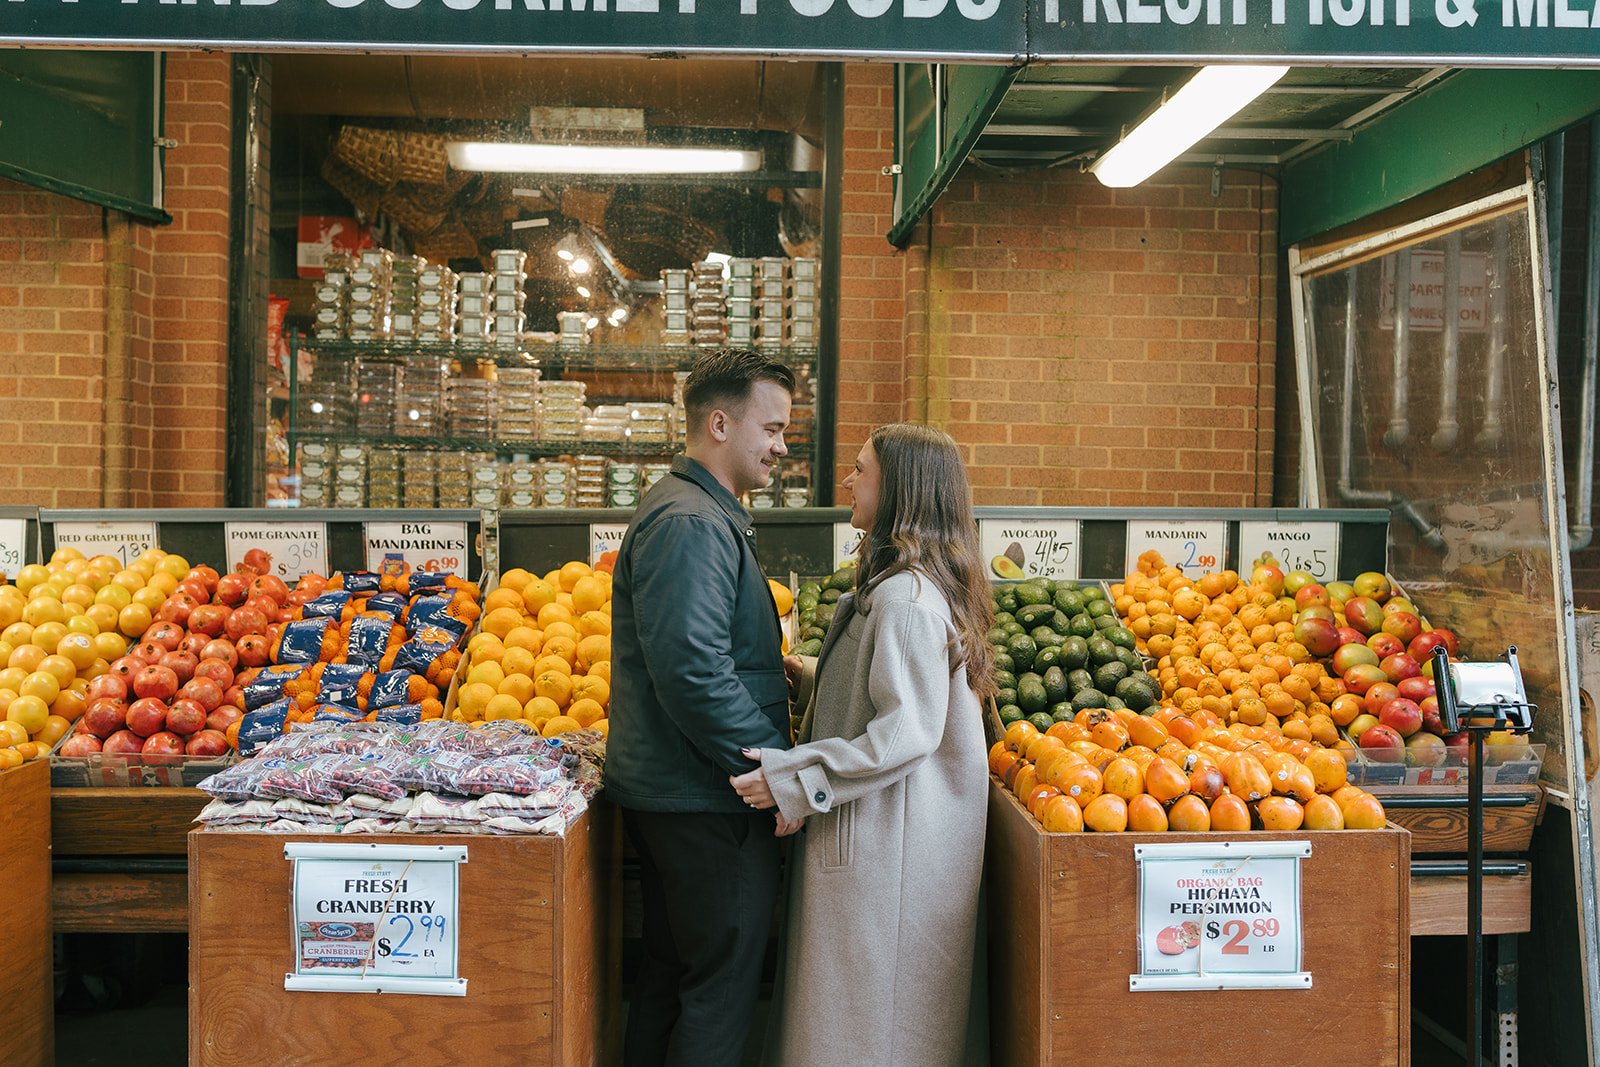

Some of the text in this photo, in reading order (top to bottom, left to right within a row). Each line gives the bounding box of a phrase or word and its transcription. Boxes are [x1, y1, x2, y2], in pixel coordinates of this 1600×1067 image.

[402, 524, 431, 534] BAG
[1000, 529, 1057, 538] AVOCADO
[59, 534, 151, 542] RED GRAPEFRUIT
[232, 530, 320, 540] POMEGRANATE
[1145, 530, 1208, 540] MANDARIN
[1268, 532, 1310, 541] MANGO
[369, 539, 464, 550] MANDARINES
[344, 880, 408, 893] FRESH
[1176, 877, 1263, 888] ORGANIC BAG
[316, 900, 436, 914] CRANBERRY
[1170, 901, 1272, 914] PERSIMMON
